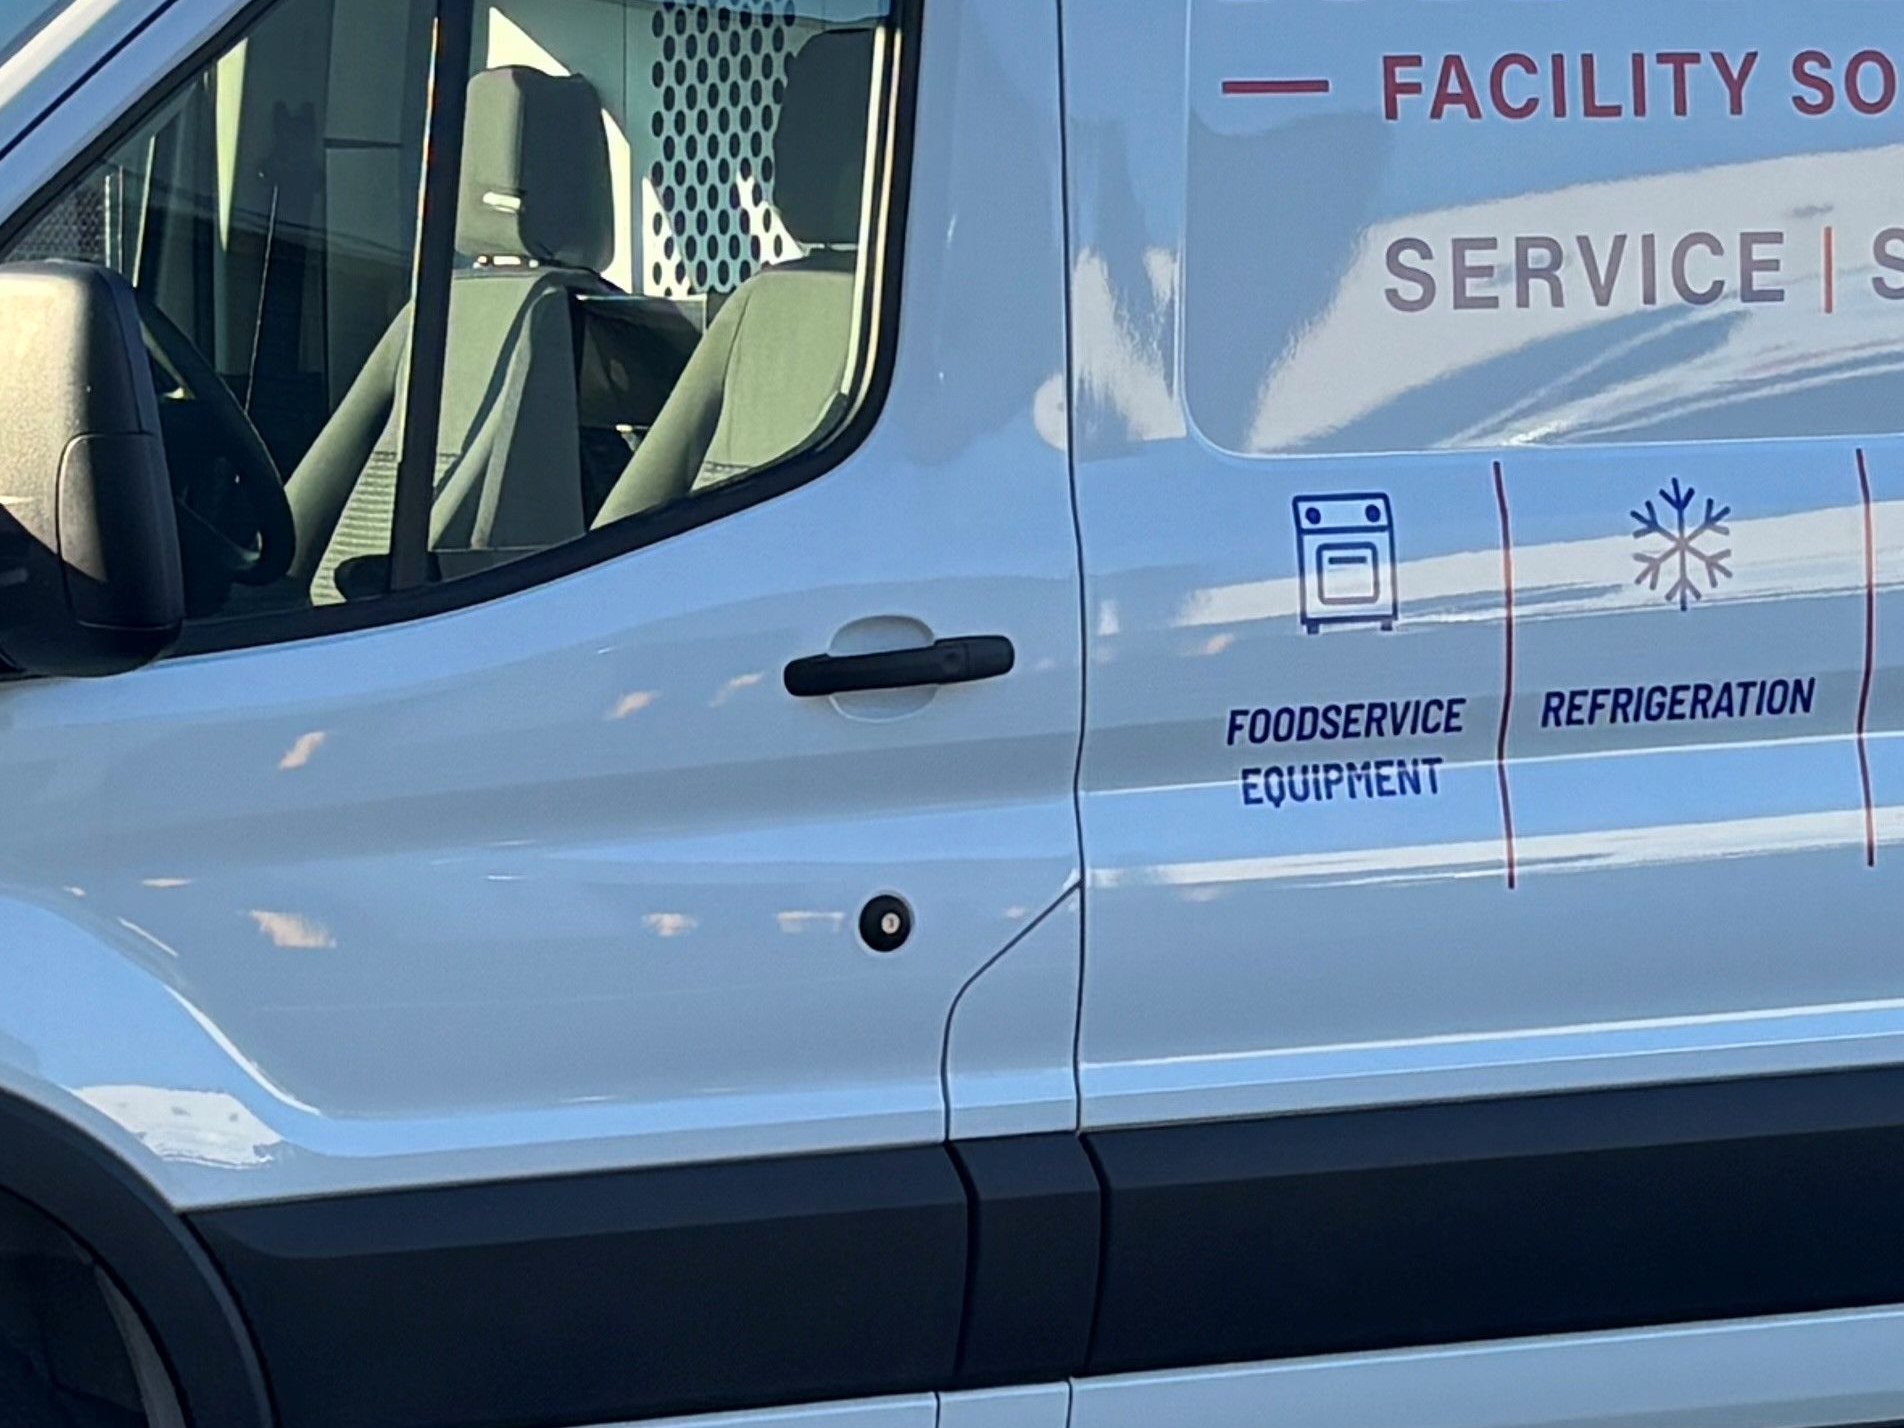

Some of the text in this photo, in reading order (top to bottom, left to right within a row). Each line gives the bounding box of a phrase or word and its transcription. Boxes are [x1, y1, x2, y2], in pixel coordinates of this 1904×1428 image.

[1381, 49, 1760, 121] FACILITY
[1382, 232, 1788, 314] SERVICE
[1225, 696, 1468, 747] FOODSERVICE
[1541, 677, 1817, 727] REFRIGERATION
[1240, 756, 1445, 808] EQUIPMENT
